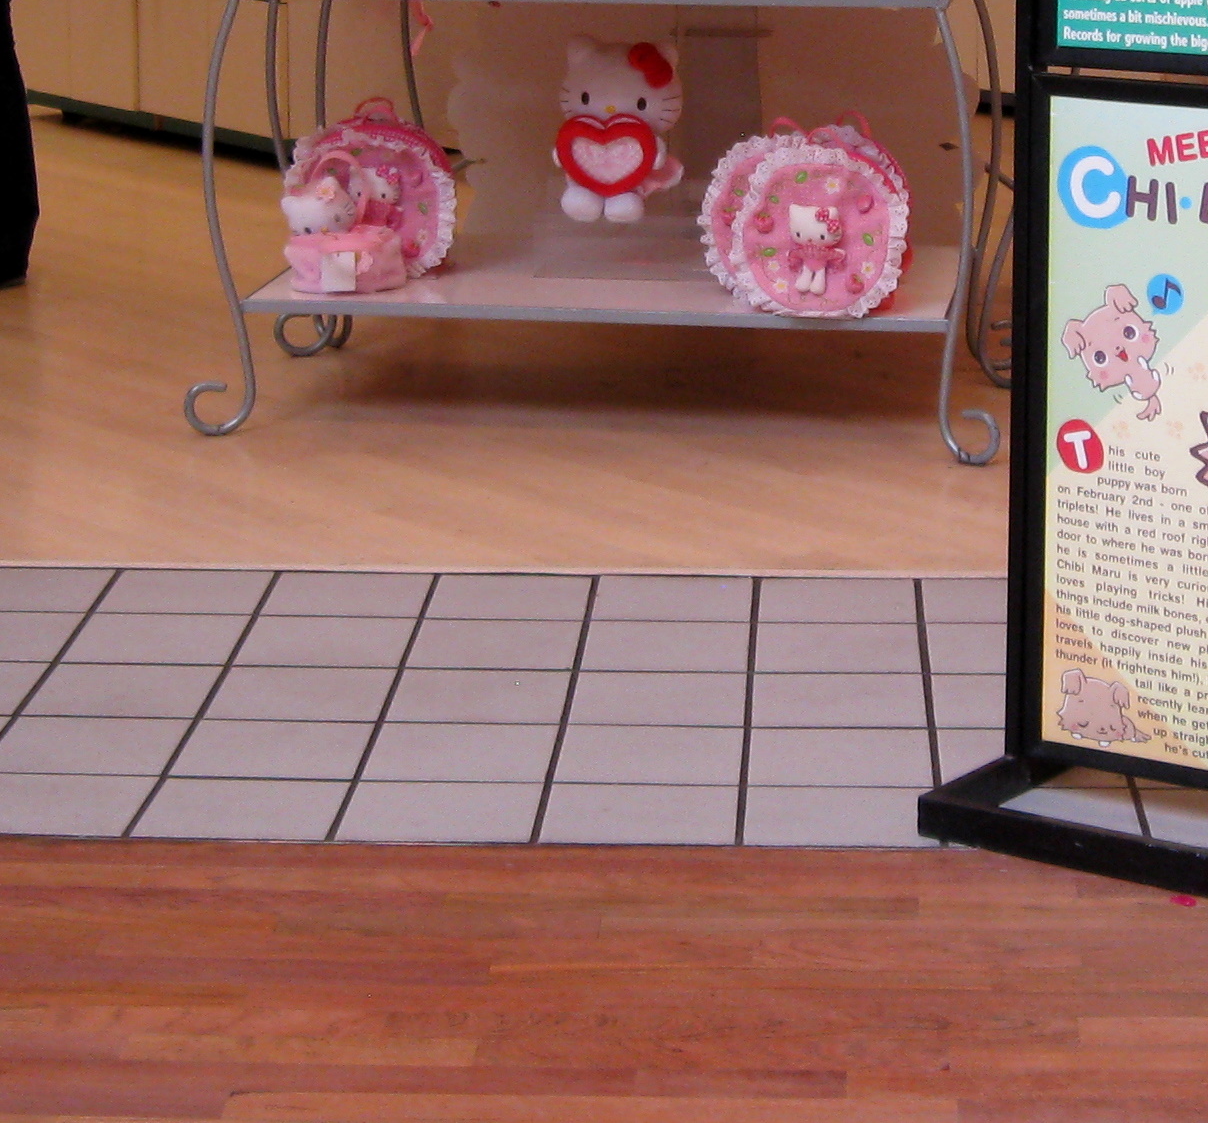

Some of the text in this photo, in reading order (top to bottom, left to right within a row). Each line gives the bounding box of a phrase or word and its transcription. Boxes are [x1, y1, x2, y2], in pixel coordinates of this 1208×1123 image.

[1062, 26, 1104, 42] Records
[1106, 29, 1122, 43] for
[1124, 33, 1168, 50] growing
[1169, 33, 1188, 47] the
[1108, 445, 1160, 462] his cute
[1108, 460, 1165, 480] little boy
[1057, 485, 1070, 494] on
[1076, 485, 1125, 505] February
[1132, 494, 1153, 507] 2nd
[1170, 503, 1192, 513] one
[1097, 476, 1187, 496] puppy was born
[1057, 499, 1098, 513] triplets!
[1105, 506, 1121, 517] He
[1128, 510, 1153, 522] lives
[1160, 514, 1171, 525] in
[1056, 513, 1089, 528] house
[1095, 522, 1118, 532] with
[1124, 526, 1131, 534] a
[1137, 529, 1156, 538] red
[1162, 532, 1185, 542] roof
[1056, 529, 1081, 542] door
[1086, 534, 1097, 544] to
[1101, 537, 1136, 550] where
[1141, 542, 1155, 553] he
[1160, 547, 1182, 557] was
[1056, 543, 1070, 555] he
[1077, 546, 1087, 558] is
[1094, 552, 1158, 569] sometimes
[1166, 564, 1174, 572] a
[1182, 564, 1208, 577] little
[1056, 573, 1084, 588] loves
[1095, 581, 1137, 599] playing
[1148, 589, 1184, 604] tricks!
